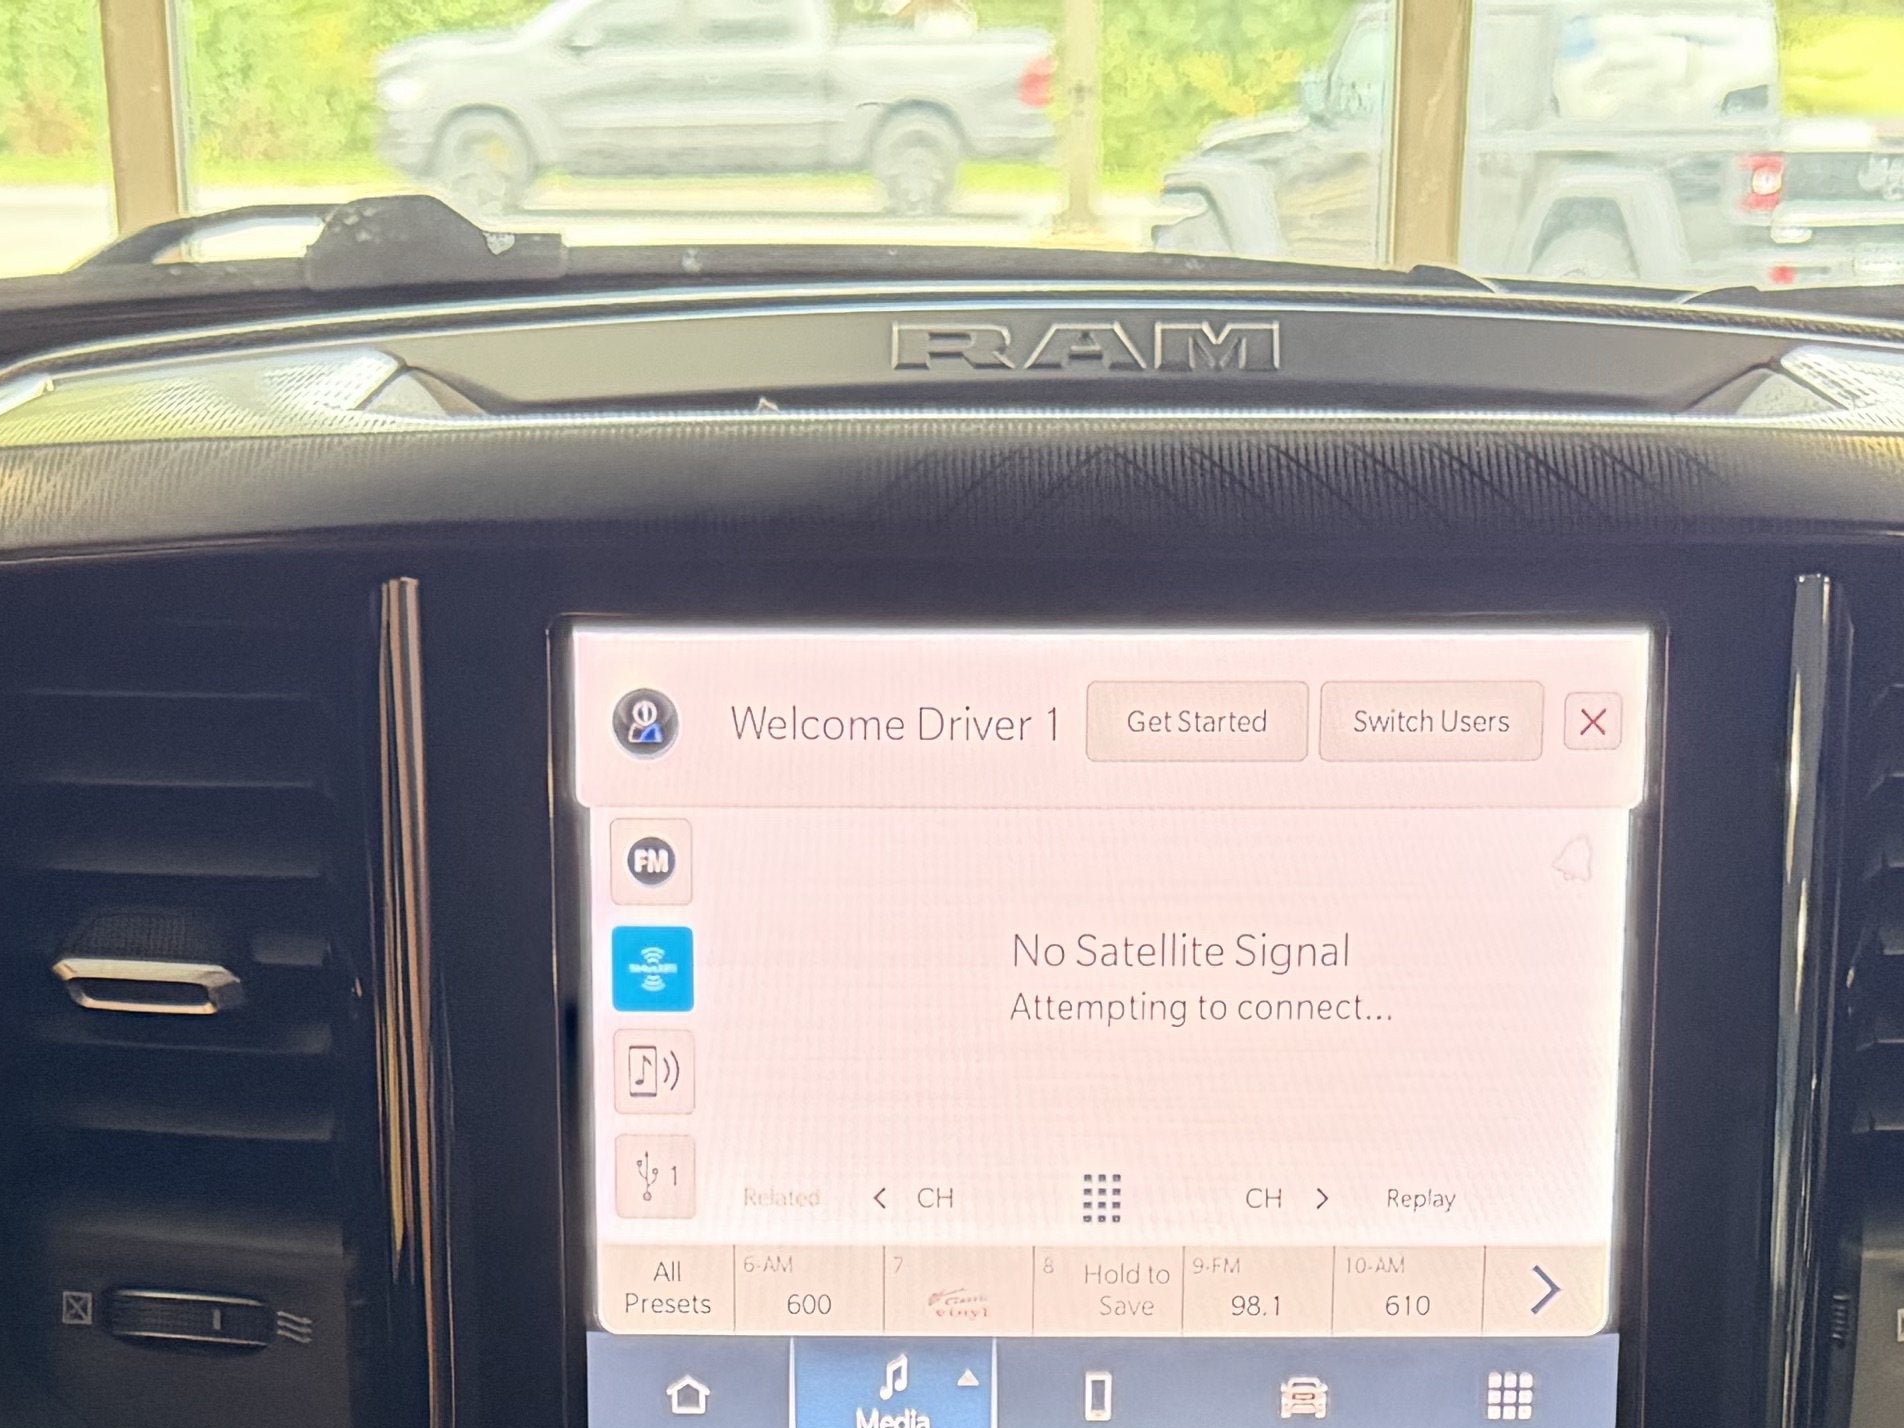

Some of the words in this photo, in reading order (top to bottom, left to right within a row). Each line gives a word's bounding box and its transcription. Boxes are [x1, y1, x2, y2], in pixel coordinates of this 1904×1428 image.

[892, 321, 1280, 371] RAM
[732, 705, 905, 740] Welcome
[919, 706, 1032, 741] Driver
[1047, 707, 1059, 740] 1
[1127, 710, 1174, 734] Get
[1178, 709, 1268, 734] Started
[1353, 709, 1434, 734] Switch
[1442, 710, 1510, 734] Users
[634, 850, 669, 873] FM
[1013, 933, 1065, 967] No
[1077, 933, 1224, 968] Satellite
[1236, 932, 1350, 975] Signal
[1011, 992, 1187, 1027] Attempting
[1198, 995, 1227, 1021] to
[1237, 994, 1393, 1021] connect...
[917, 1188, 954, 1210] CH
[1245, 1188, 1283, 1209] CH
[1387, 1188, 1456, 1211] Replay
[654, 1261, 682, 1283] All
[1085, 1264, 1141, 1285] Hold
[1148, 1266, 1170, 1285] to
[1346, 1256, 1406, 1274] 10-AM
[625, 1293, 711, 1315] Presets
[787, 1295, 832, 1316] 600
[1099, 1296, 1155, 1317] Save
[1231, 1295, 1282, 1317] 98.1
[1385, 1295, 1431, 1317] 610
